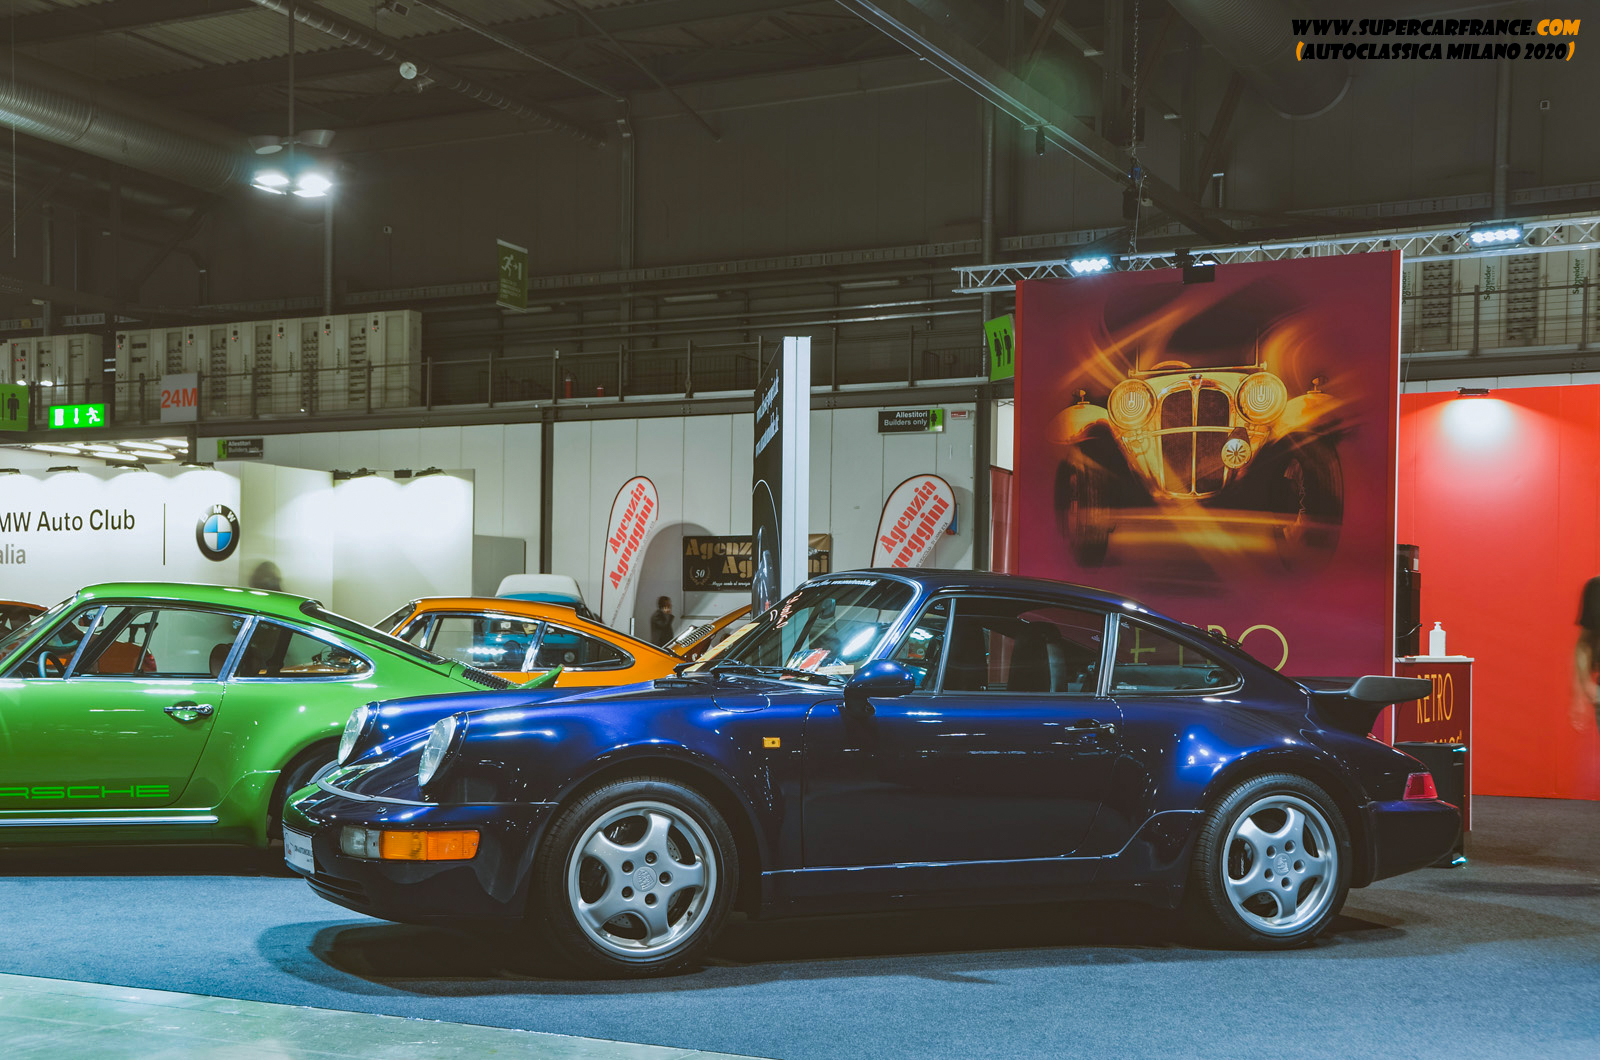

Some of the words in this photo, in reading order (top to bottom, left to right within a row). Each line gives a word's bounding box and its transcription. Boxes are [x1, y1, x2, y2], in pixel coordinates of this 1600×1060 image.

[161, 387, 197, 408] 24M
[913, 418, 928, 426] only
[37, 511, 83, 532] Auto
[89, 508, 135, 531] Club
[609, 482, 646, 555] Agenzia
[880, 481, 937, 554] Agenzia
[609, 494, 654, 590] Aguggini
[686, 538, 753, 560] Agenz
[695, 569, 705, 578] 50
